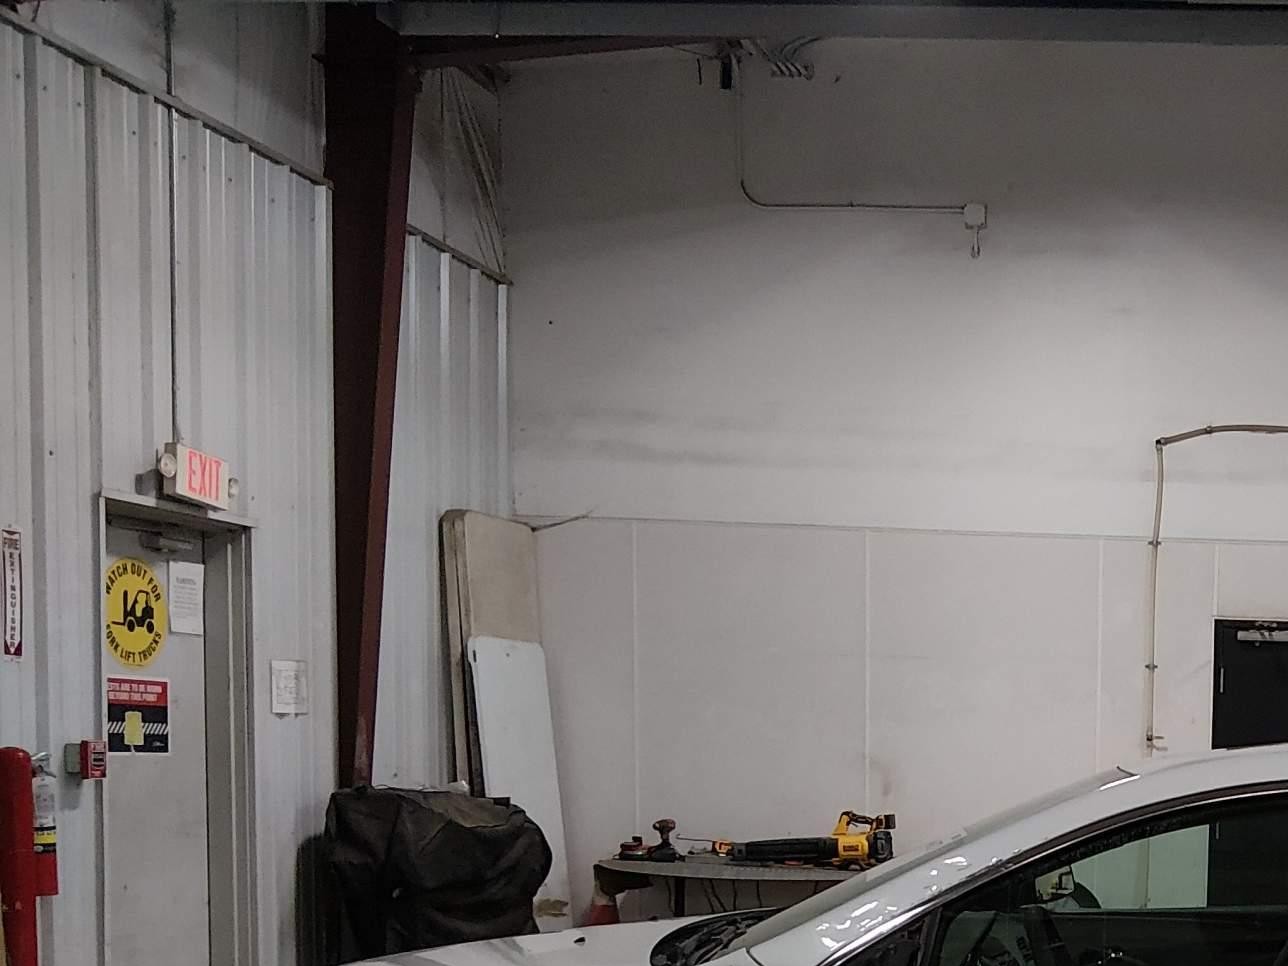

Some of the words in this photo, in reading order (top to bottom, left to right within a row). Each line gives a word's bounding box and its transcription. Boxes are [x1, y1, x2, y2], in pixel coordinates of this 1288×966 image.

[187, 449, 224, 501] EXIT
[105, 562, 128, 595] WATCH
[130, 562, 148, 580] OUT
[146, 577, 162, 602] FOR
[120, 647, 136, 663] LIFT
[138, 631, 162, 662] TRUCKS
